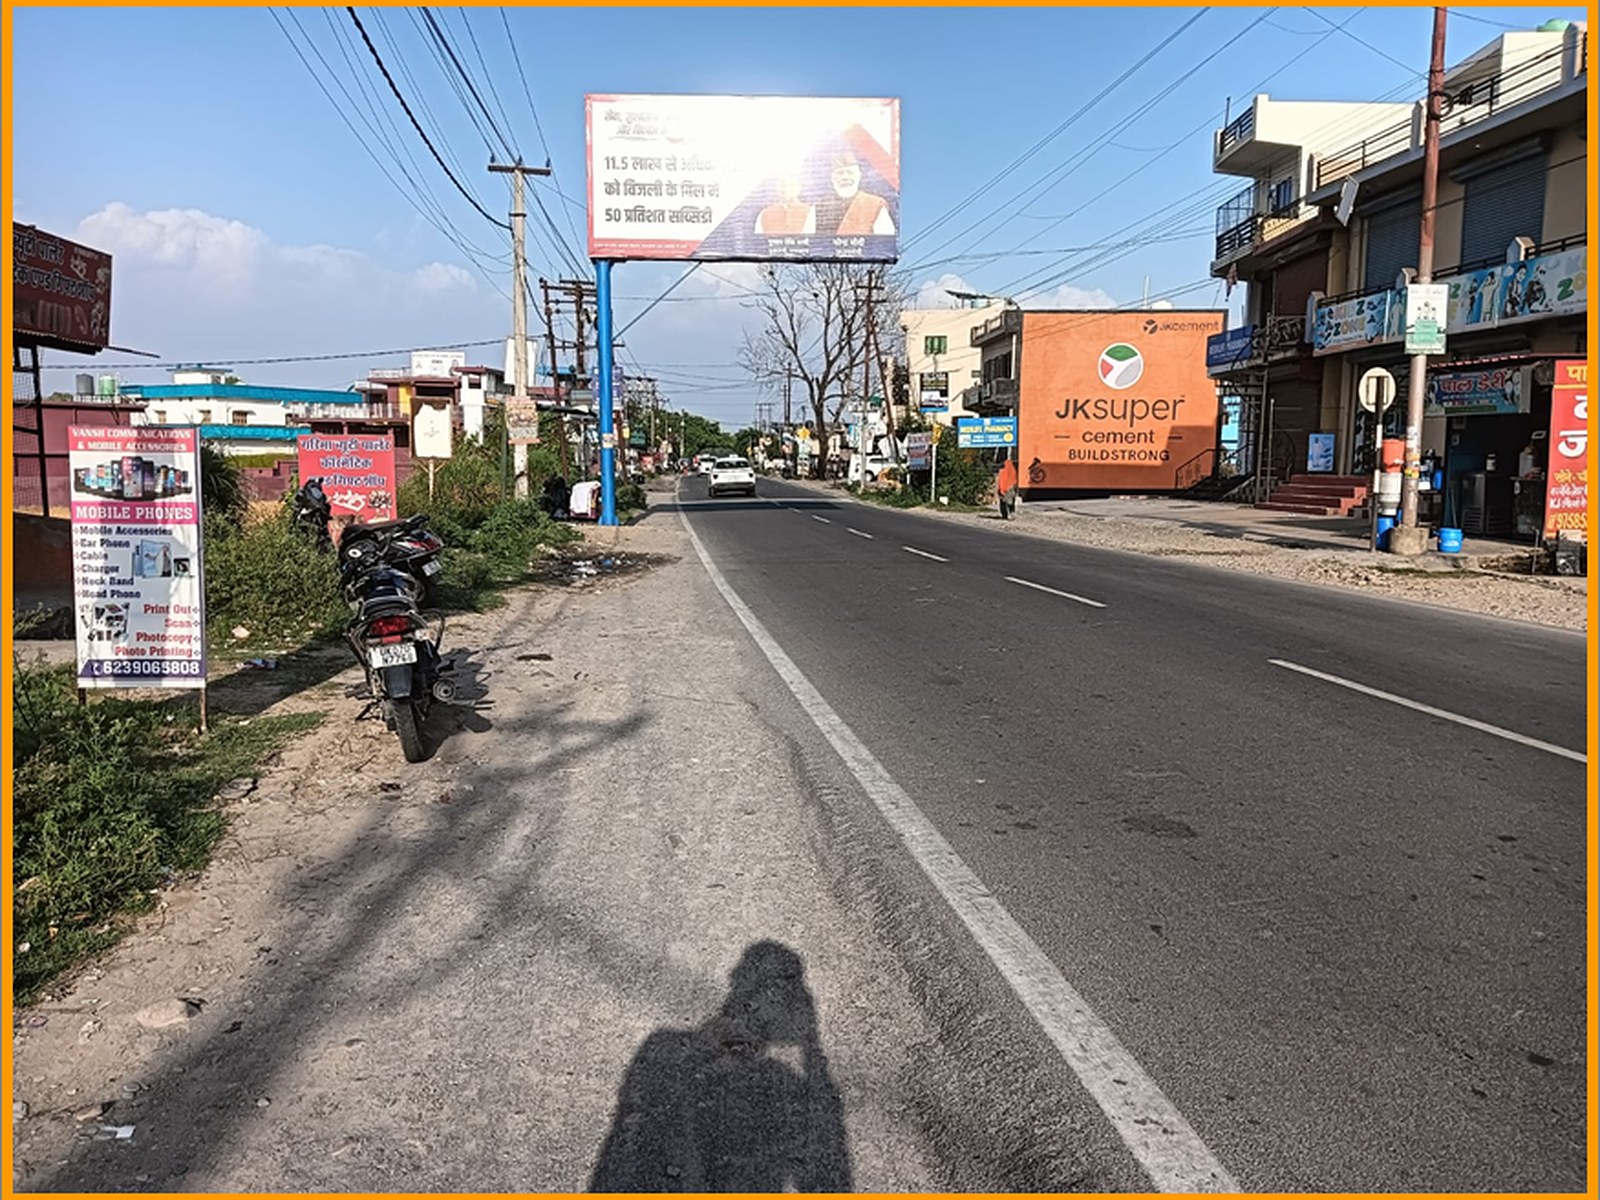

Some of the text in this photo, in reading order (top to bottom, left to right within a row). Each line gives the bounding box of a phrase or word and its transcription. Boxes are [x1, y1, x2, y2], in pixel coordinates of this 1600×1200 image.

[604, 157, 628, 170] 11.5
[604, 178, 620, 196] को
[665, 180, 678, 196] के
[605, 208, 621, 222] 50
[624, 205, 665, 223] प्रतिशत
[72, 428, 192, 439] VANSH COMMUNICATIONS
[1081, 430, 1154, 444] cement
[88, 441, 122, 450] MOBILE
[125, 441, 187, 451] ACCESSORIES
[1068, 449, 1169, 461] BUILDSTRONG
[76, 506, 193, 520] MOBILE PHONES
[80, 526, 173, 536] Mobile Accessories
[100, 539, 130, 549] Phone
[80, 551, 108, 560] Cable
[81, 564, 120, 575] Charger
[82, 577, 134, 586] Neck Band
[110, 589, 142, 599] Phone
[143, 603, 192, 614] Print Out
[135, 631, 192, 644] Photocopy
[115, 646, 192, 658] Photo Printing
[103, 661, 200, 674] 6239065808
